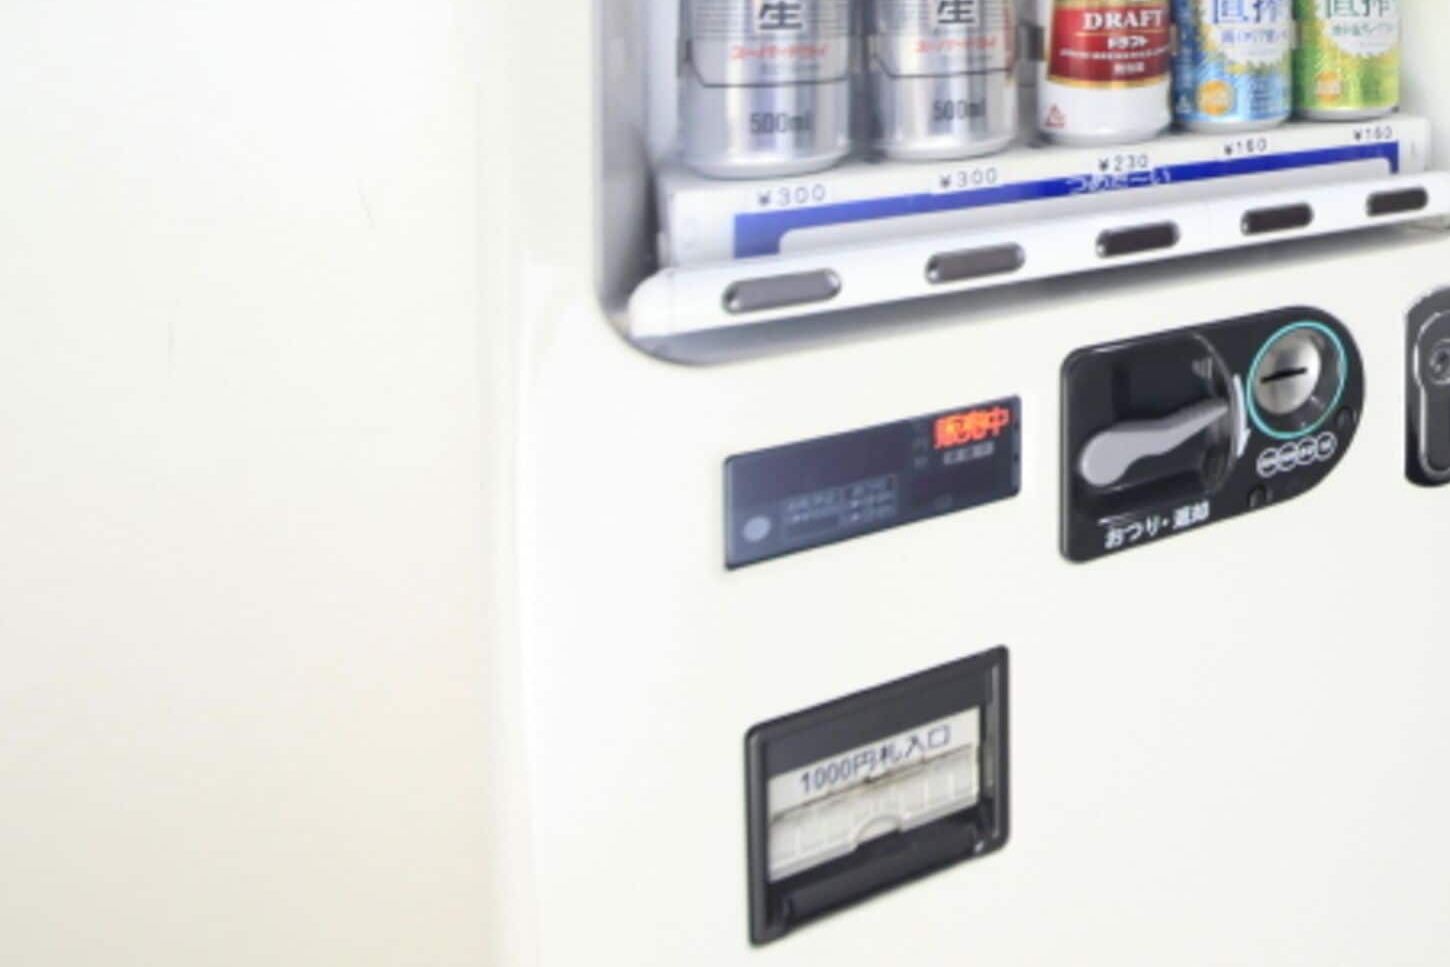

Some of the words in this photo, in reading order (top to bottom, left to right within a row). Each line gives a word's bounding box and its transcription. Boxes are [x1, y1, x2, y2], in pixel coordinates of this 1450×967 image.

[759, 0, 804, 31] 生
[1082, 8, 1164, 31] DRAFT
[1098, 153, 1150, 173] ¥230
[939, 167, 999, 190] ¥300
[757, 183, 827, 207] ¥300
